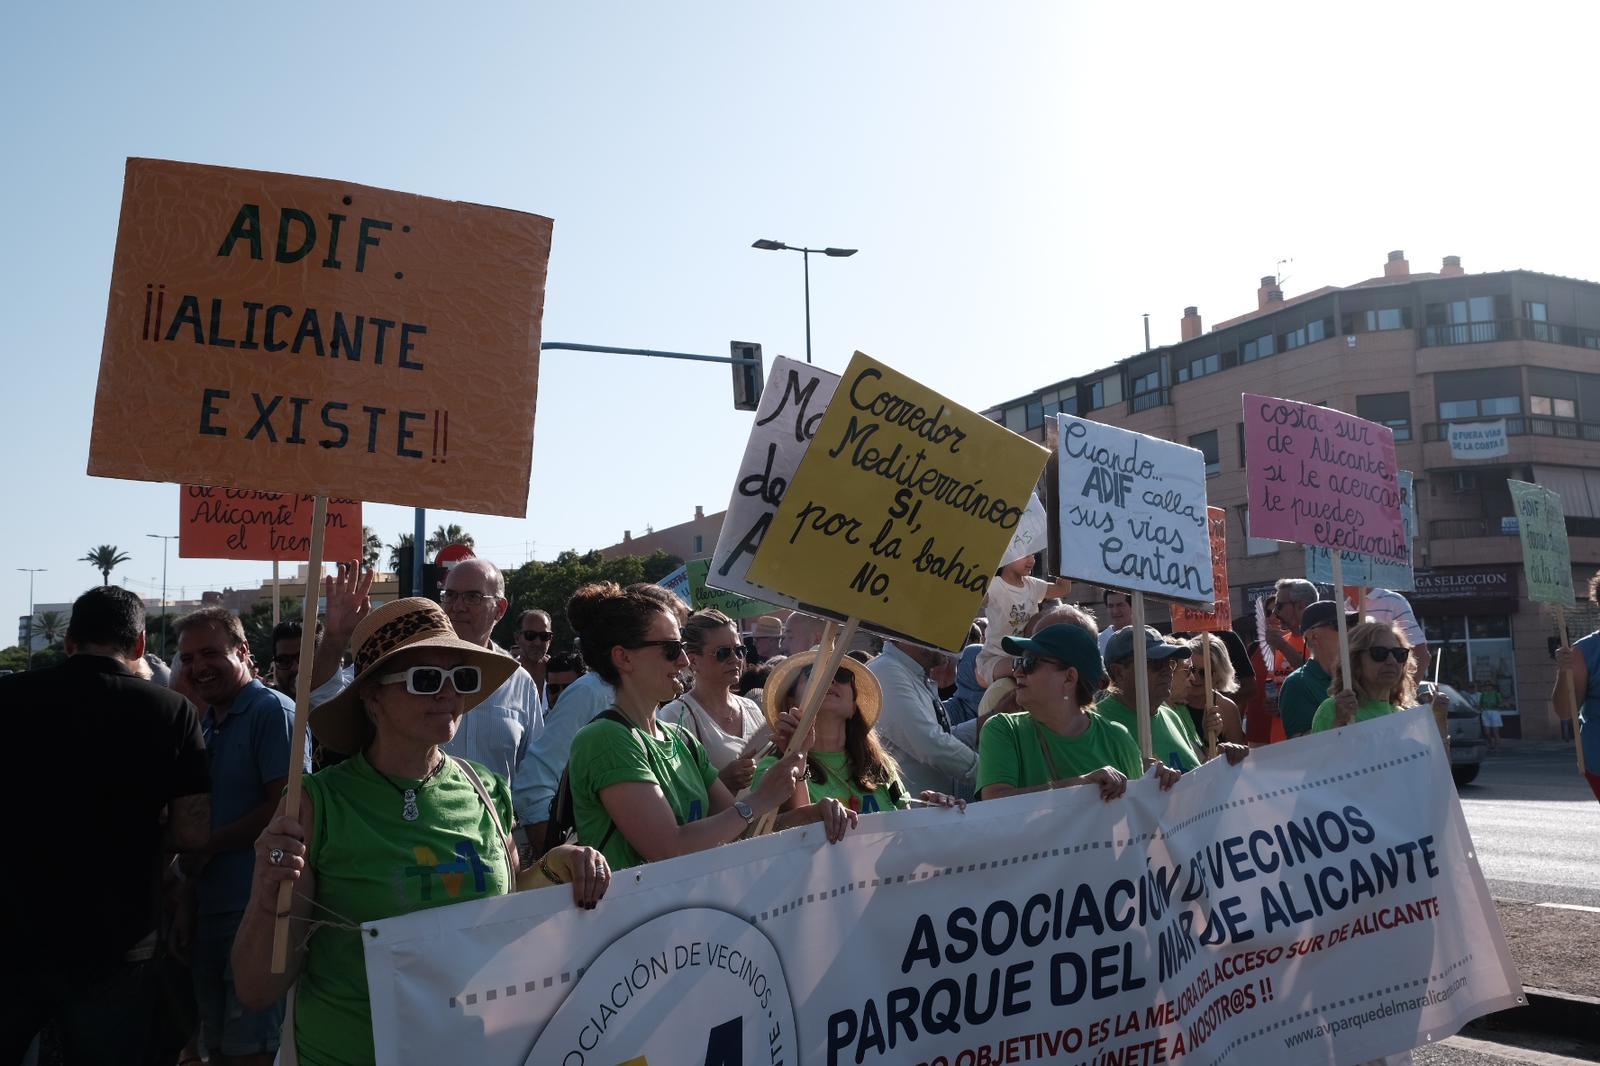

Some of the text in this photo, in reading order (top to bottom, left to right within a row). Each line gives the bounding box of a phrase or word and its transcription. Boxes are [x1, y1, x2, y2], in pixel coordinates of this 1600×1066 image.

[199, 388, 449, 464] EXISTE!!
[849, 367, 967, 453] Corredor
[1260, 403, 1375, 446] costa sur
[829, 415, 1024, 529] Mediterráneo
[1263, 458, 1287, 482] si
[1266, 426, 1394, 482] de Alicante,
[190, 499, 294, 526] Alicante
[790, 500, 863, 545] por
[1081, 466, 1205, 527] ADIF calla,
[1291, 497, 1365, 526] puedes
[226, 524, 311, 551] el tren
[869, 518, 902, 560] la
[1069, 505, 1185, 554] sus vias
[849, 561, 890, 603] NO.
[912, 536, 990, 597] bahía
[1099, 536, 1213, 595] Cantan
[1415, 573, 1507, 587] GA SELECCION
[901, 857, 1182, 973] ASOCIACIÓN
[1205, 805, 1376, 889] VECINOS
[826, 834, 1440, 1066] PARQUE DEL MAR DE ALICANTE
[562, 942, 773, 1066] OCIACIÓN DE VECINOS
[955, 896, 1440, 1066] OBJETIVO ES LA MEJORA DEL ACCESO SUR DE ALICANTE
[1170, 1031, 1186, 1060] A
[1188, 984, 1256, 1052] NOSOTR@S
